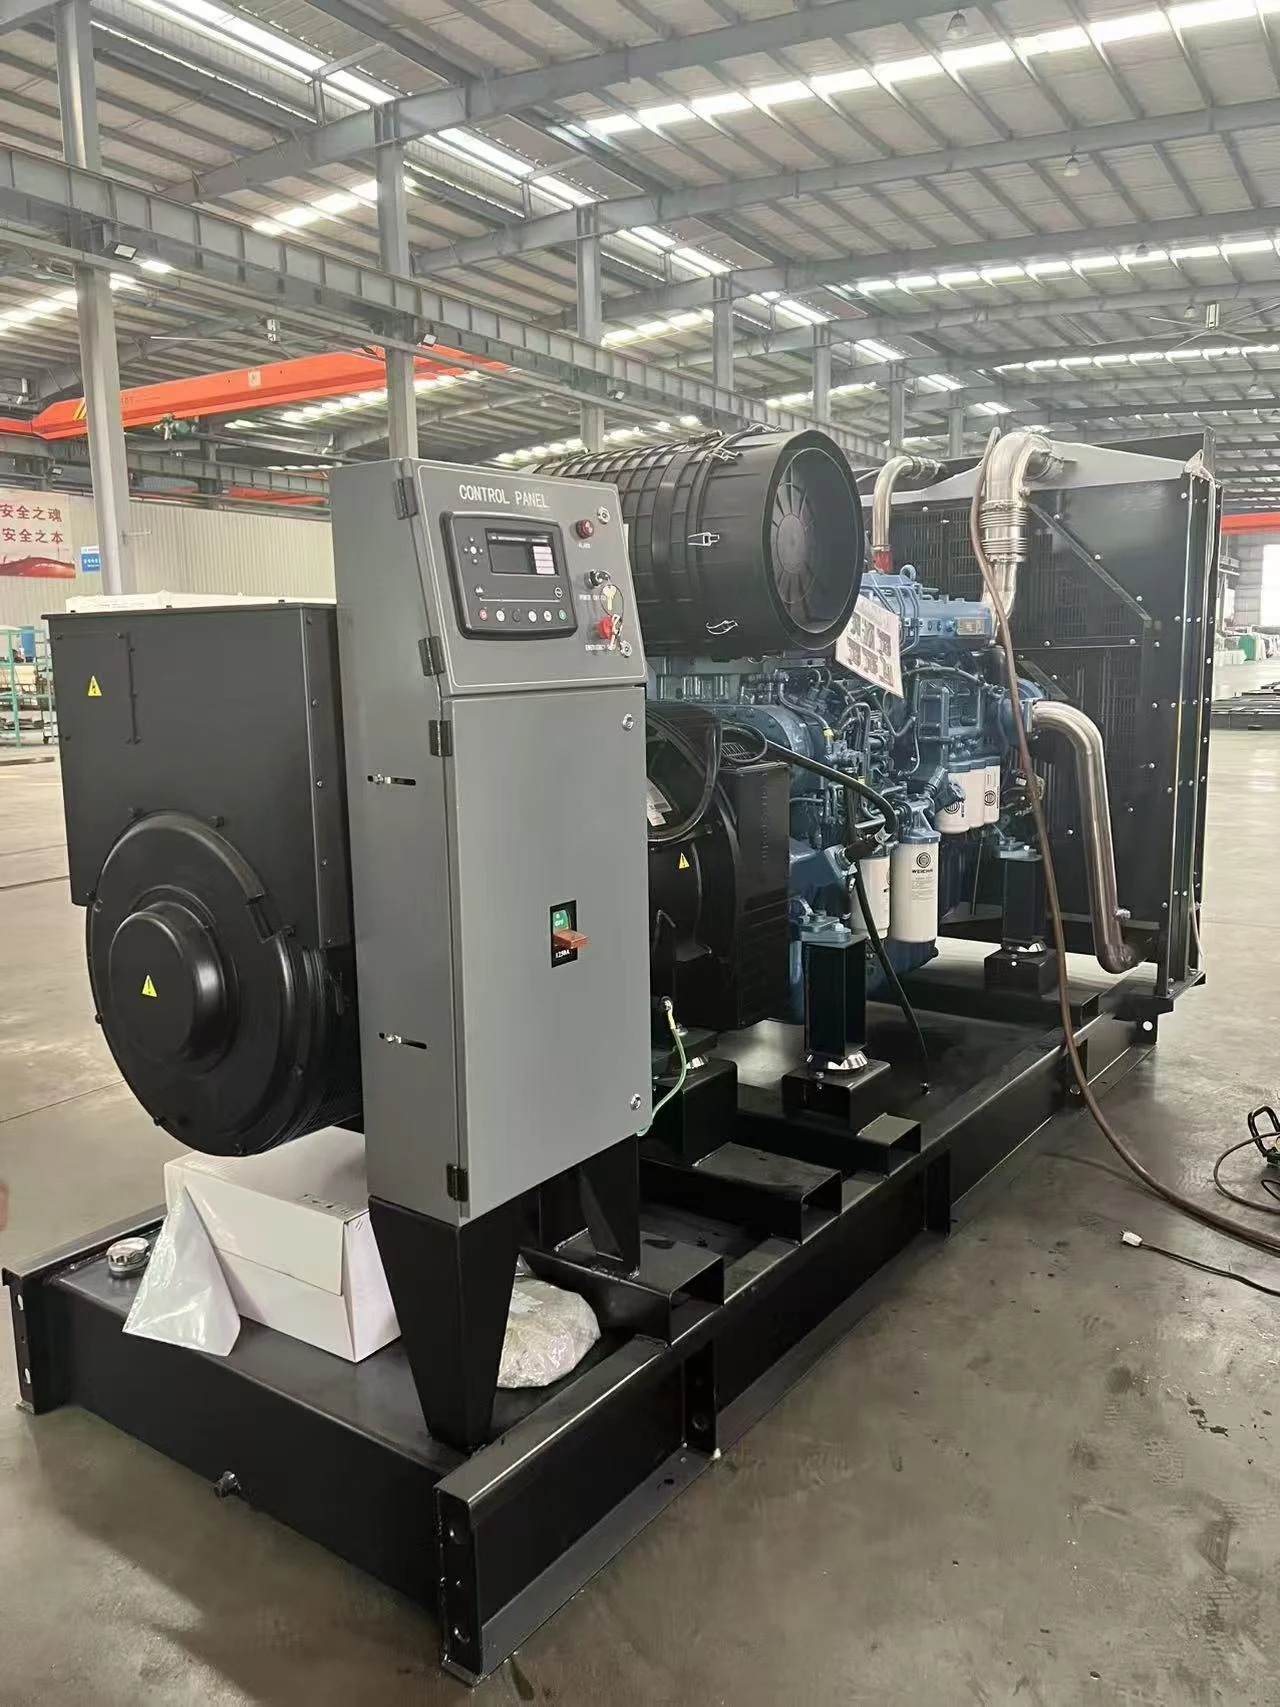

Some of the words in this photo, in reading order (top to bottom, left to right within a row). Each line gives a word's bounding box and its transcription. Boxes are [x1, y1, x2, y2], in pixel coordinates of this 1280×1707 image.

[459, 484, 510, 504] CONTROL
[515, 491, 549, 508] PANEL
[0, 504, 62, 522] 安全之魂
[2, 528, 64, 544] 安全之本
